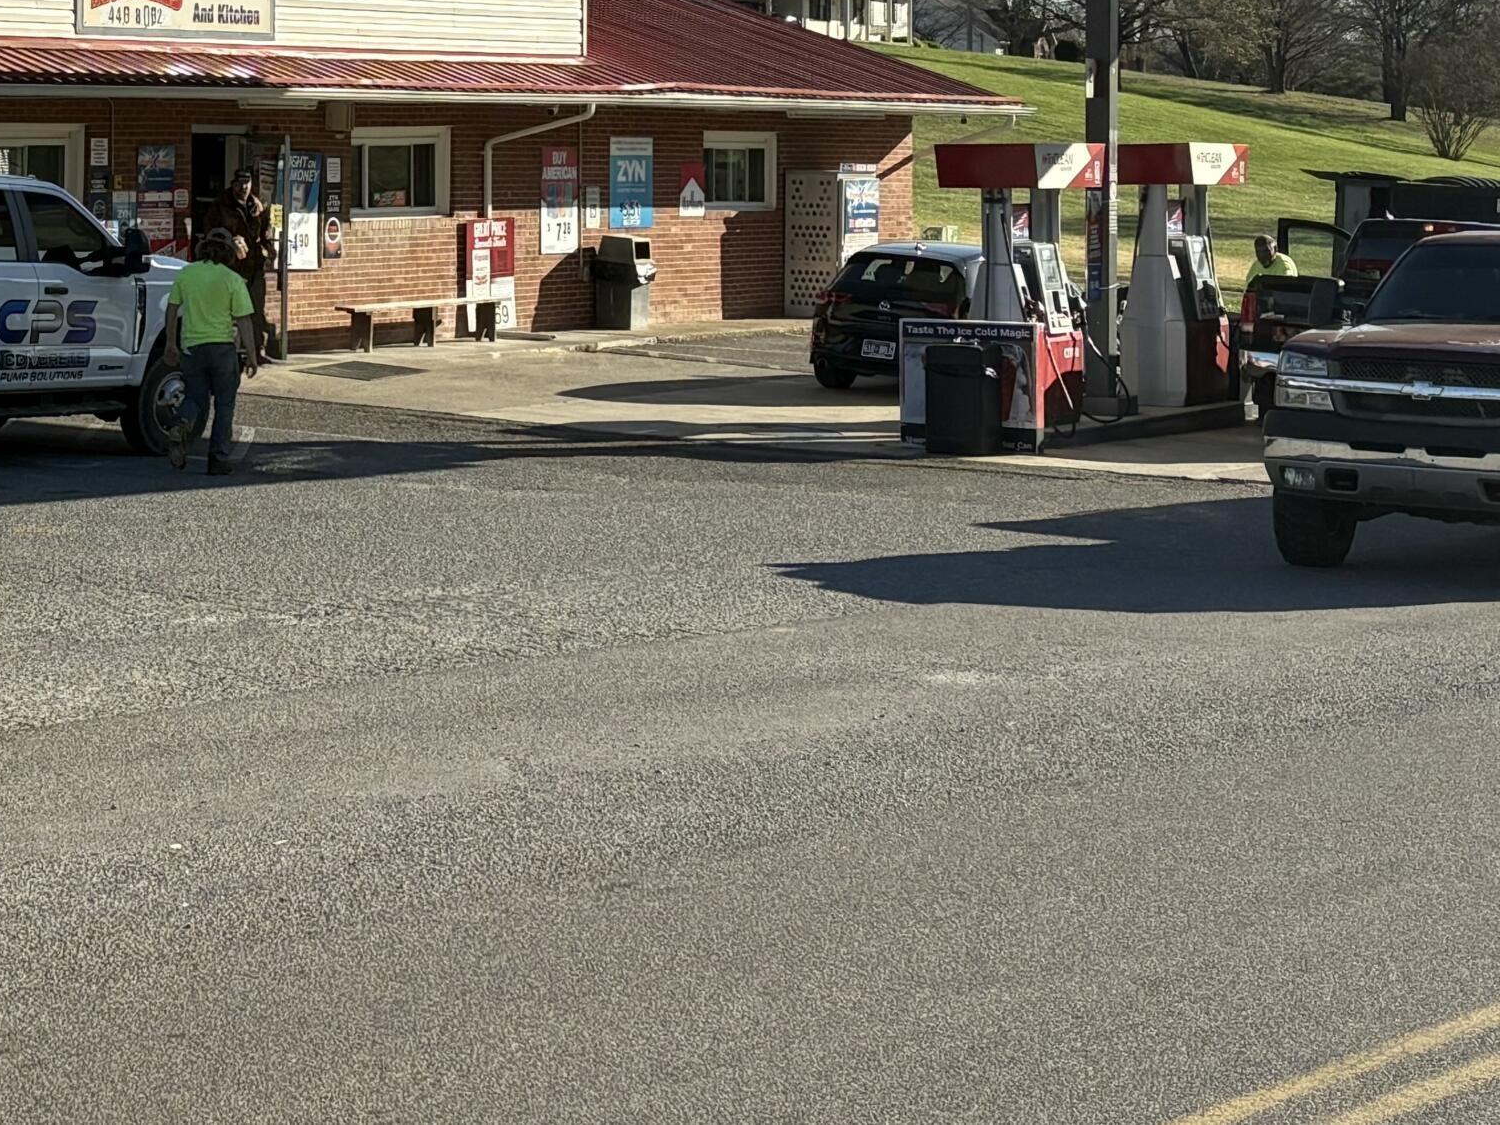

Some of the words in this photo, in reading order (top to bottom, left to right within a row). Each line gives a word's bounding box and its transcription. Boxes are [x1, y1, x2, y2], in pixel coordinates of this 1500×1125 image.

[193, 2, 214, 24] And
[217, 4, 260, 26] Kitchen
[552, 150, 567, 165] BUY
[290, 170, 320, 182] MONEY
[542, 165, 578, 180] AMERICAN
[617, 159, 646, 183] ZYN
[905, 325, 934, 335] Taste
[936, 326, 955, 335] The
[957, 327, 972, 336] Ice
[974, 327, 998, 337] Cold
[1000, 329, 1031, 339] Magic
[2, 352, 88, 368] CONCRETE
[0, 372, 29, 382] PUMP
[30, 370, 84, 382] SOLUTIONS
